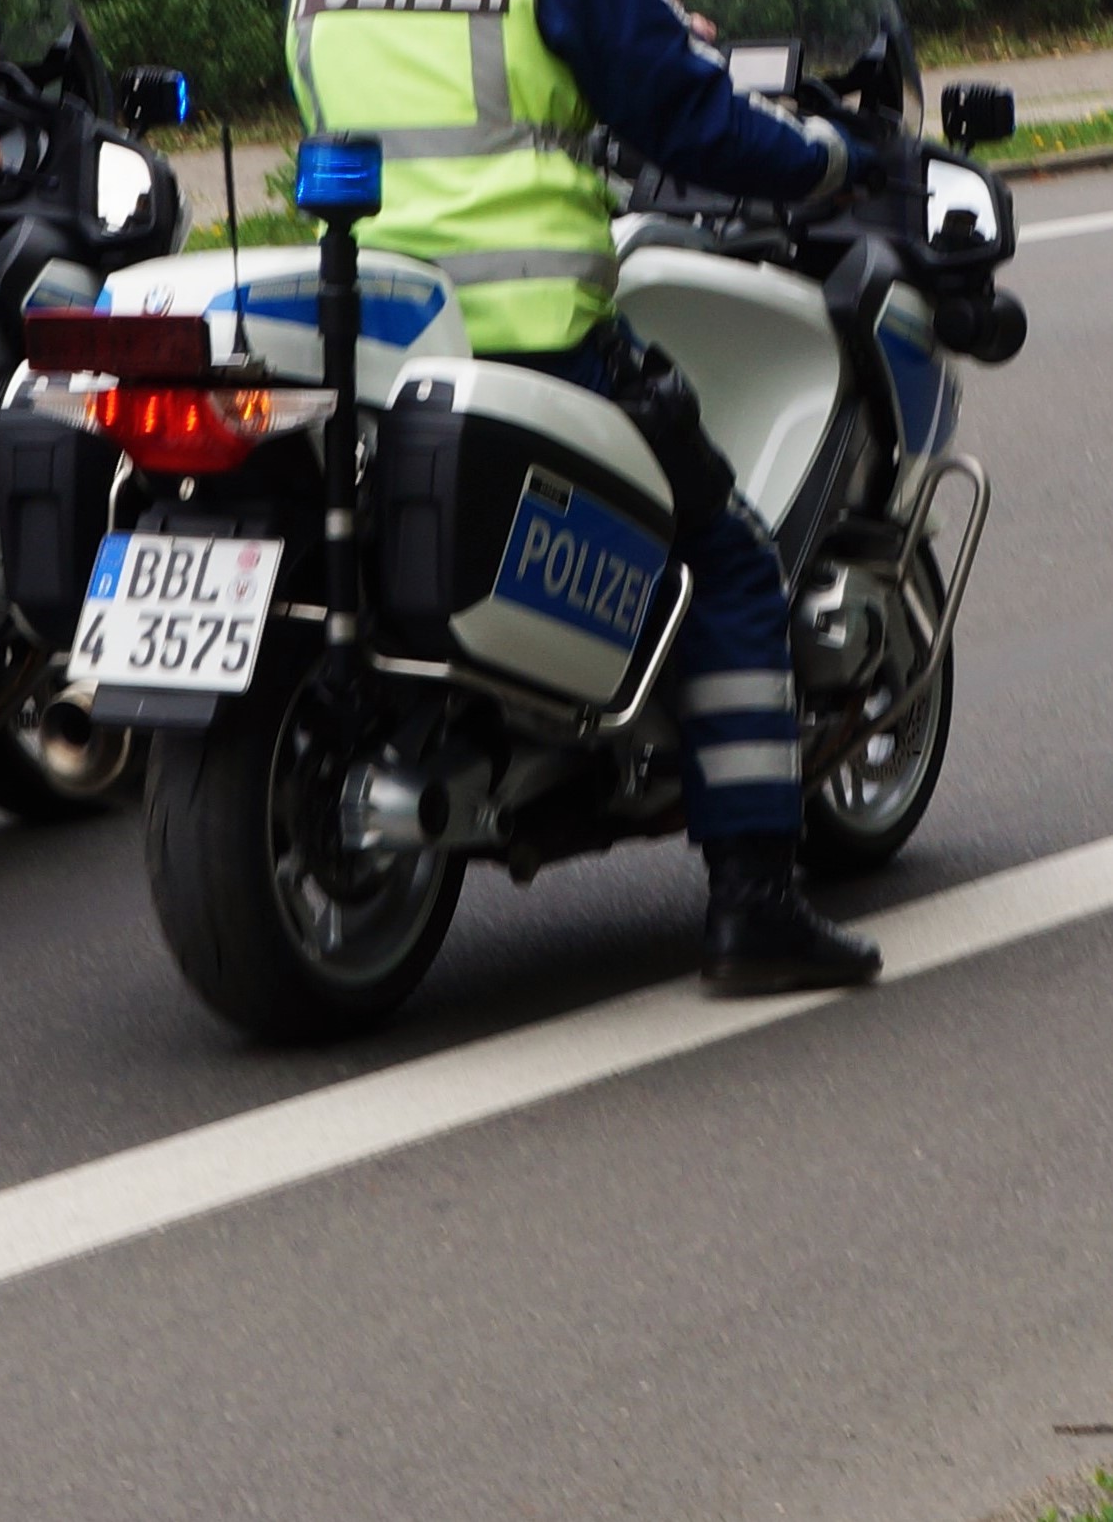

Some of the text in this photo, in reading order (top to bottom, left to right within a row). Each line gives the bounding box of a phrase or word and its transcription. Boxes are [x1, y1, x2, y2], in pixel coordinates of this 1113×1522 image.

[126, 543, 219, 602] BBL
[515, 515, 652, 635] POLIZEI
[79, 610, 257, 672] 4 3575
